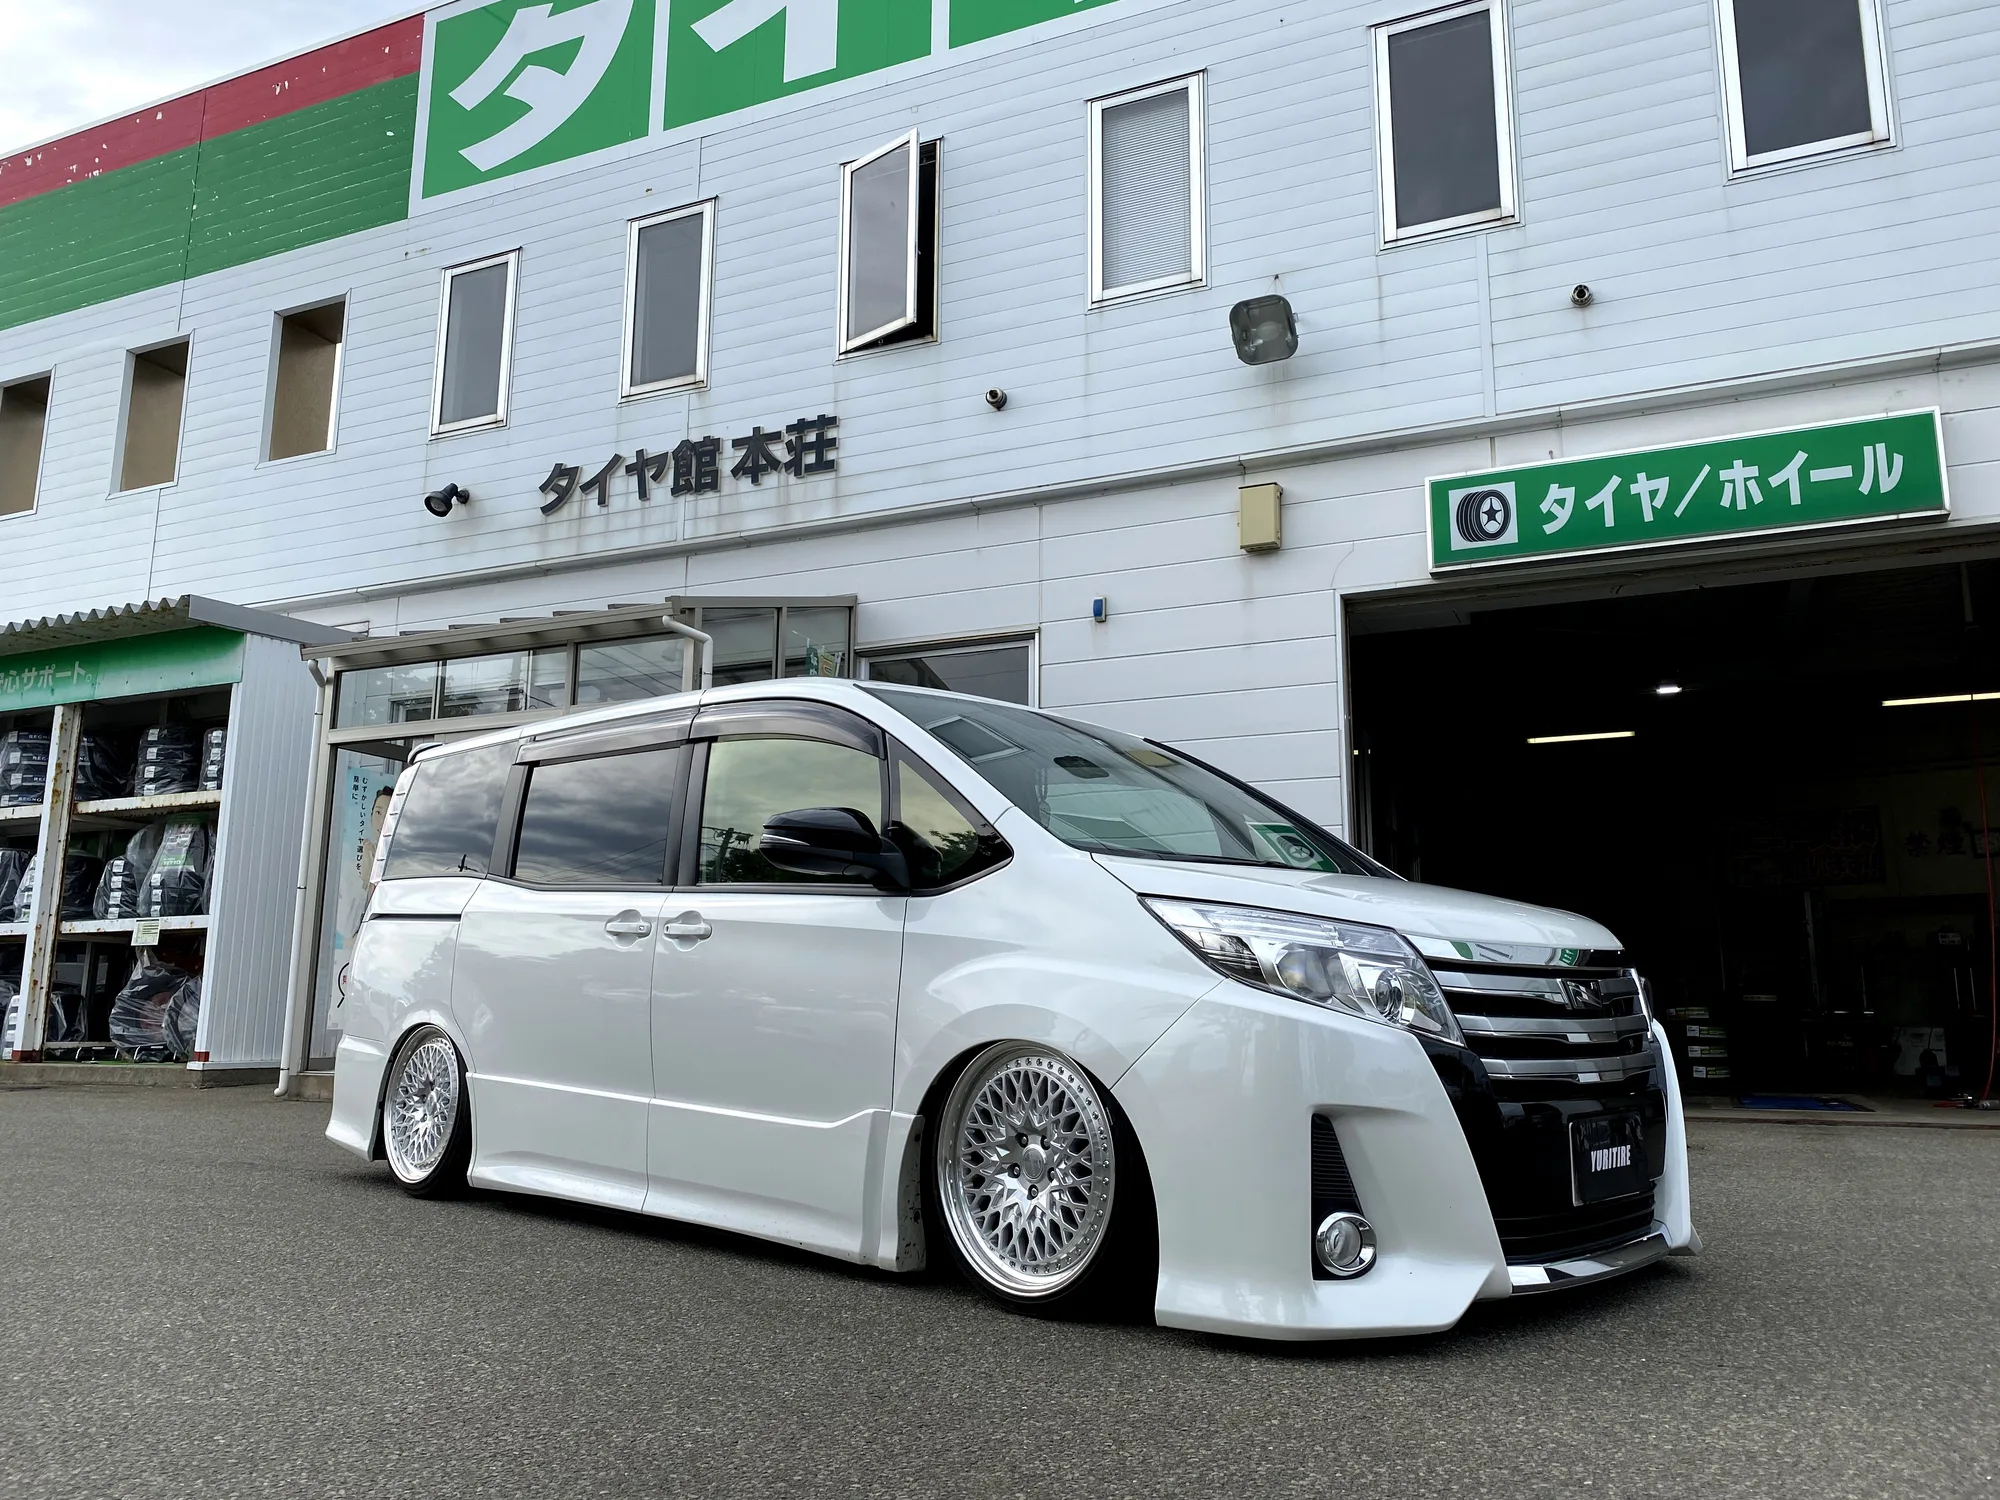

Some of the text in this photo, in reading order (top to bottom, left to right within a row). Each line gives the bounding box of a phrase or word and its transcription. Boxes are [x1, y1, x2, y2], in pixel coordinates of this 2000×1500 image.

[538, 413, 839, 516] タイヤ館本荘
[1590, 1144, 1631, 1173] YURITIRE
